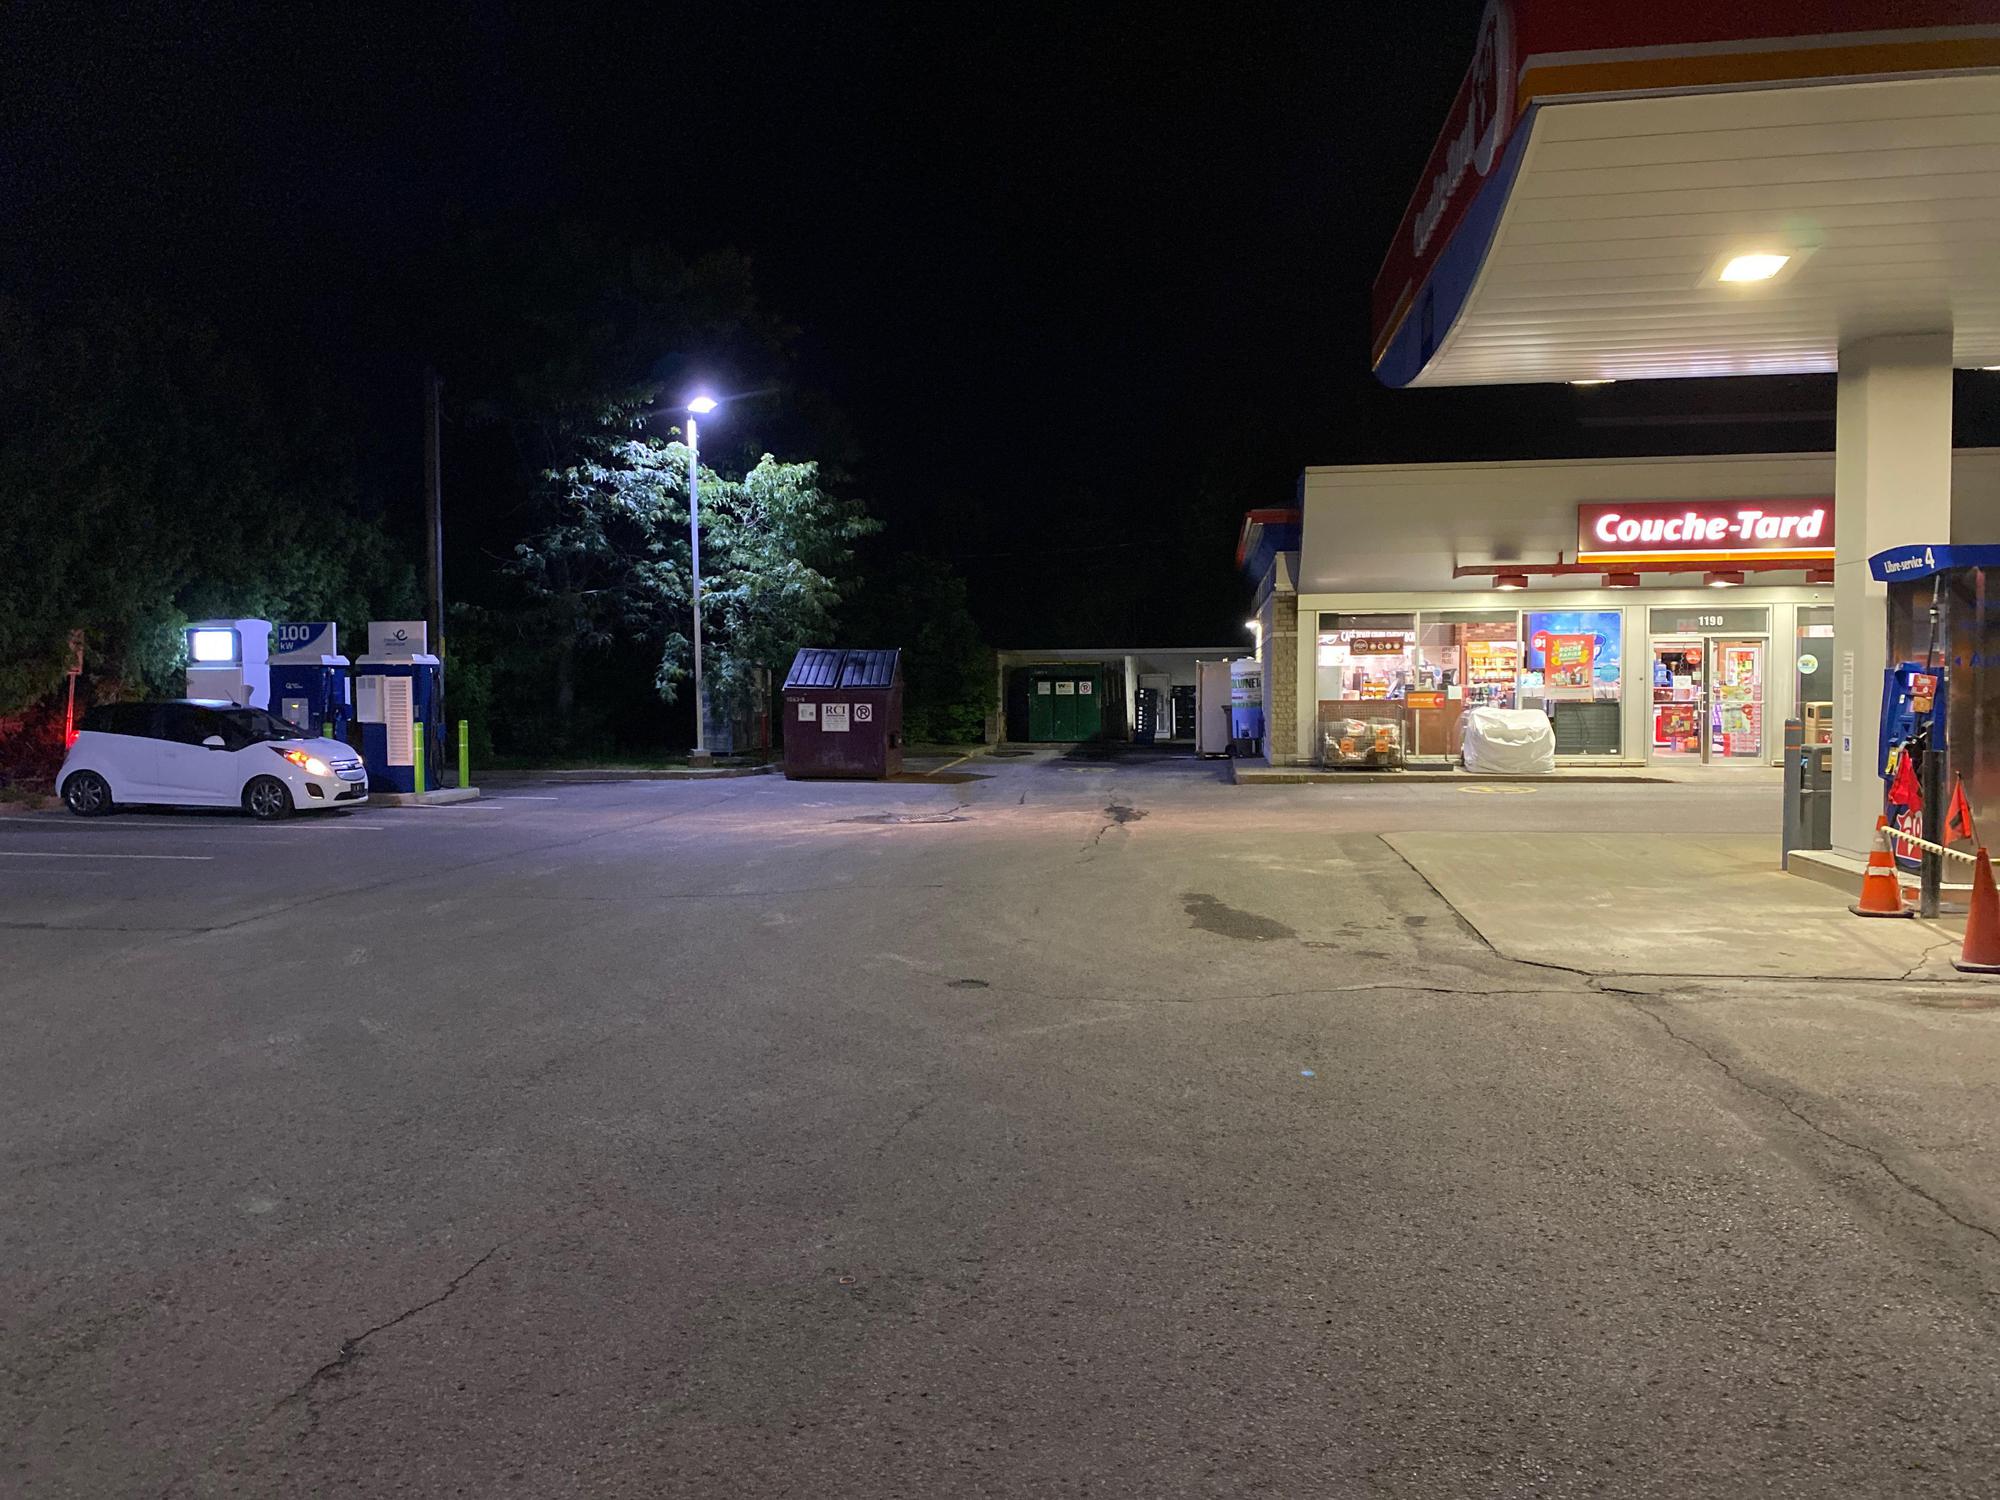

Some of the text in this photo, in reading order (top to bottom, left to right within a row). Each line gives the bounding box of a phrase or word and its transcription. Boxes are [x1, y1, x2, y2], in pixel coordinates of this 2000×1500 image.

[1596, 509, 1825, 542] Couche-Tard
[1884, 547, 1935, 574] Libre-service 4
[1698, 615, 1724, 626] 1190
[279, 625, 309, 641] 100
[280, 642, 294, 650] kW
[825, 705, 846, 715] RCI
